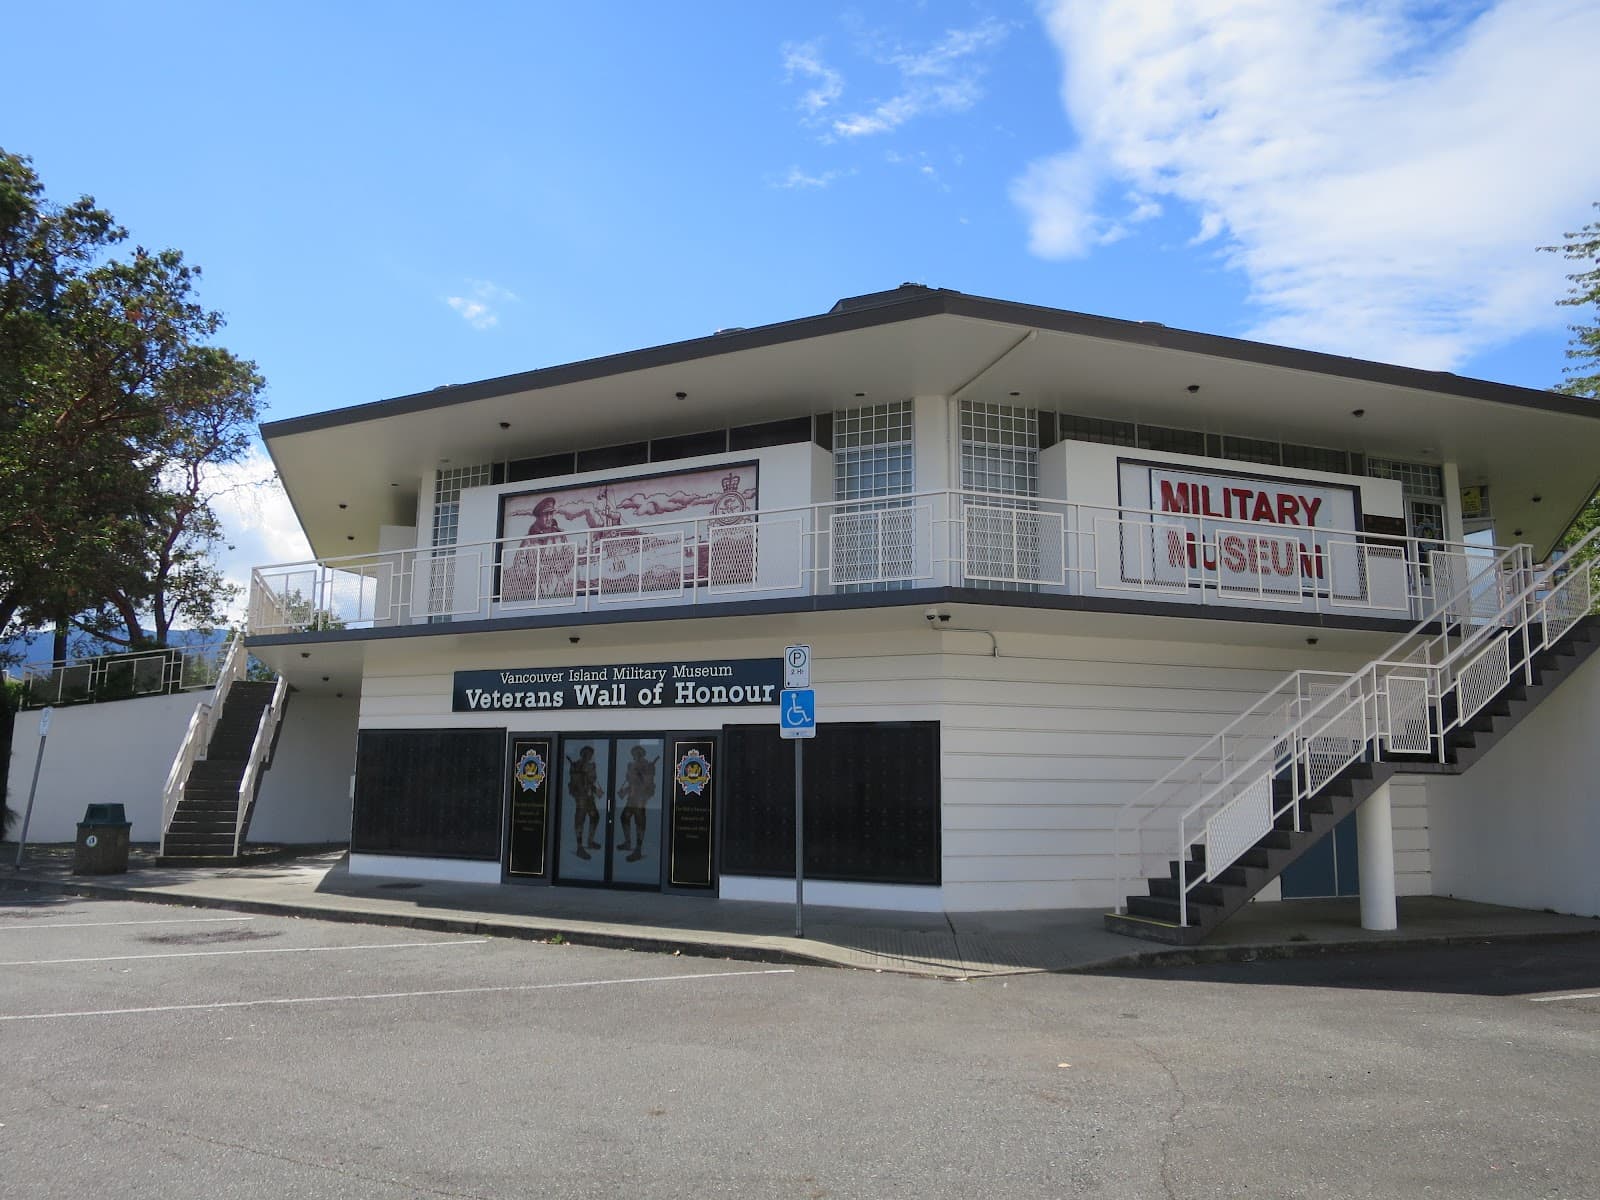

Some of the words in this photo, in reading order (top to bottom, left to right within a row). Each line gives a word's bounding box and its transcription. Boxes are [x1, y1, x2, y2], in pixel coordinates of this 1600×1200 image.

[1160, 479, 1322, 527] MILITARY
[1167, 529, 1324, 579] MUSEUM
[793, 652, 802, 665] P
[500, 671, 564, 684] Vancouver
[568, 668, 608, 682] Island
[613, 665, 667, 682] Military
[672, 664, 733, 679] Museum
[465, 688, 564, 709] Veterans
[573, 683, 627, 706] Wall
[637, 682, 664, 706] of
[674, 681, 775, 704] Honour
